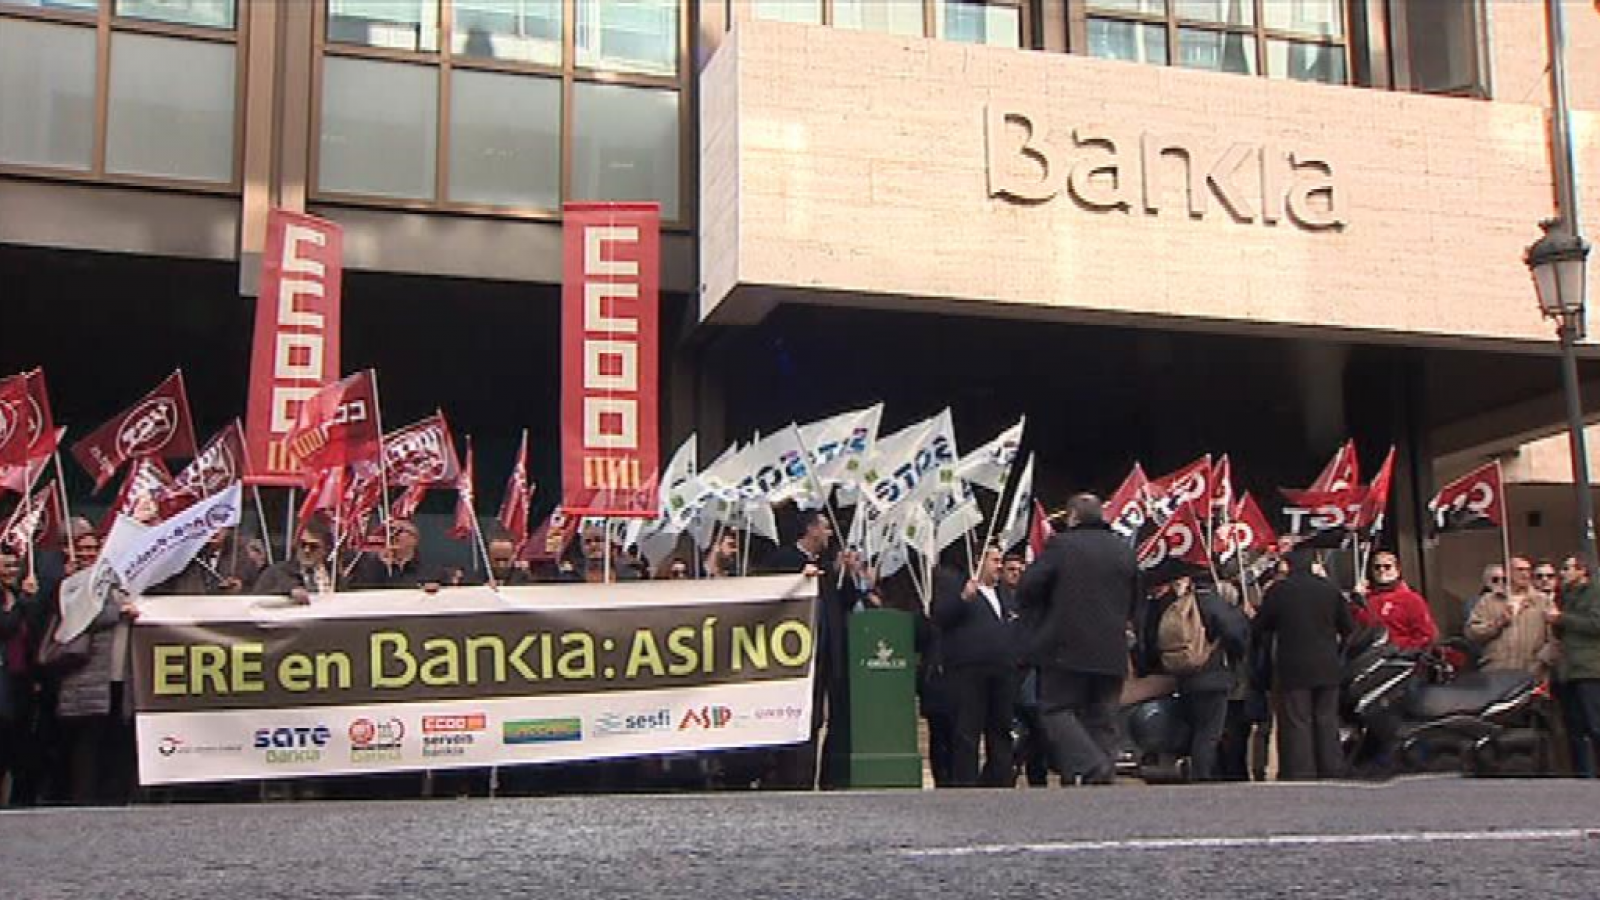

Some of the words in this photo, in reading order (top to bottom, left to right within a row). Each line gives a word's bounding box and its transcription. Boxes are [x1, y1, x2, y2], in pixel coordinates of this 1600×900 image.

[983, 104, 1346, 233] Bankia
[583, 226, 638, 448] CCOO
[154, 643, 265, 695] ERE
[278, 651, 350, 692] en
[625, 617, 718, 678] ASÍ
[731, 620, 813, 670] NO
[625, 708, 671, 730] sesfi
